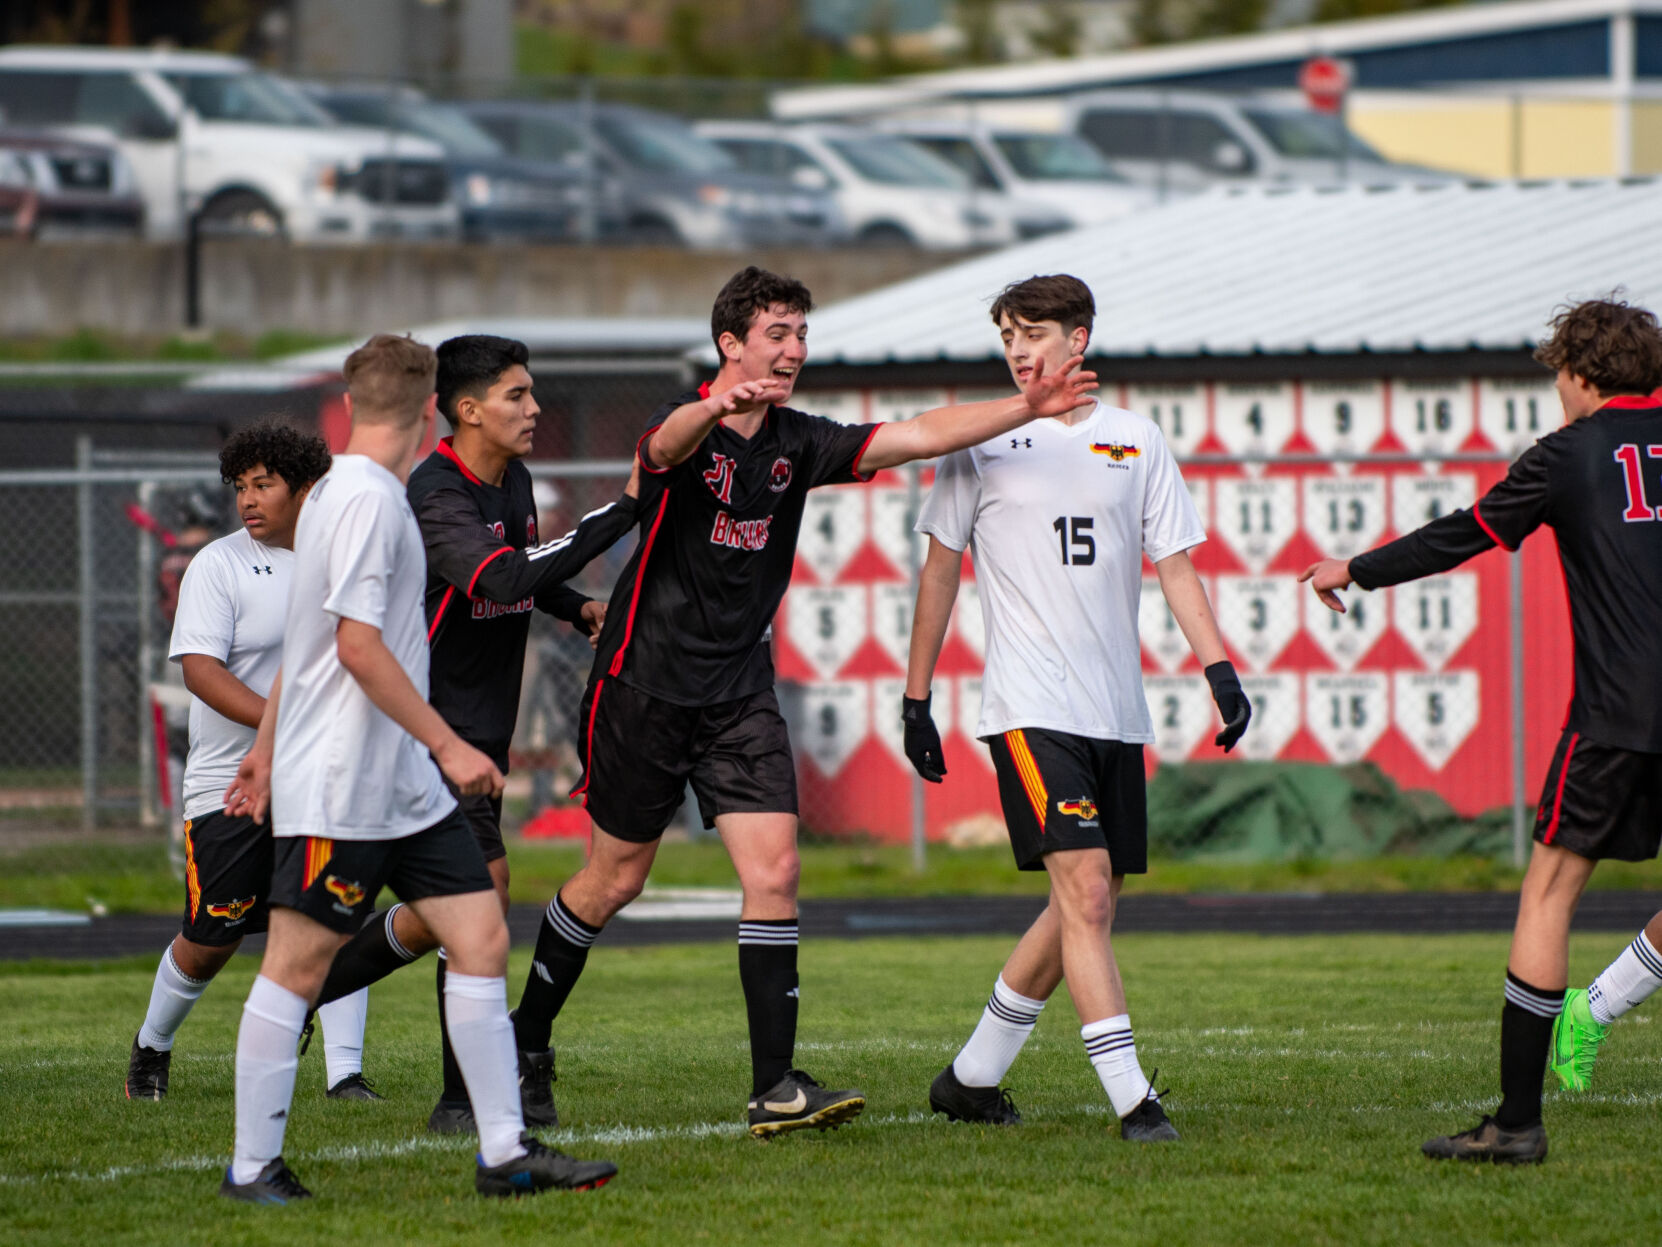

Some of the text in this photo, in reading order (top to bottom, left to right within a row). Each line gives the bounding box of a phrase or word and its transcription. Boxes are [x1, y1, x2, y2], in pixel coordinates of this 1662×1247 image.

[1246, 401, 1263, 436] 4
[1335, 401, 1353, 435] 9
[1416, 399, 1451, 432] 16
[1505, 398, 1538, 432] 11
[815, 511, 834, 543] 4
[1241, 501, 1272, 533] 11
[1329, 500, 1364, 532] 13
[1053, 516, 1096, 566] 15
[1249, 597, 1267, 631] 3
[1419, 596, 1451, 630] 11
[1164, 695, 1180, 727] 2
[1331, 695, 1367, 728] 15
[1428, 691, 1445, 726] 5
